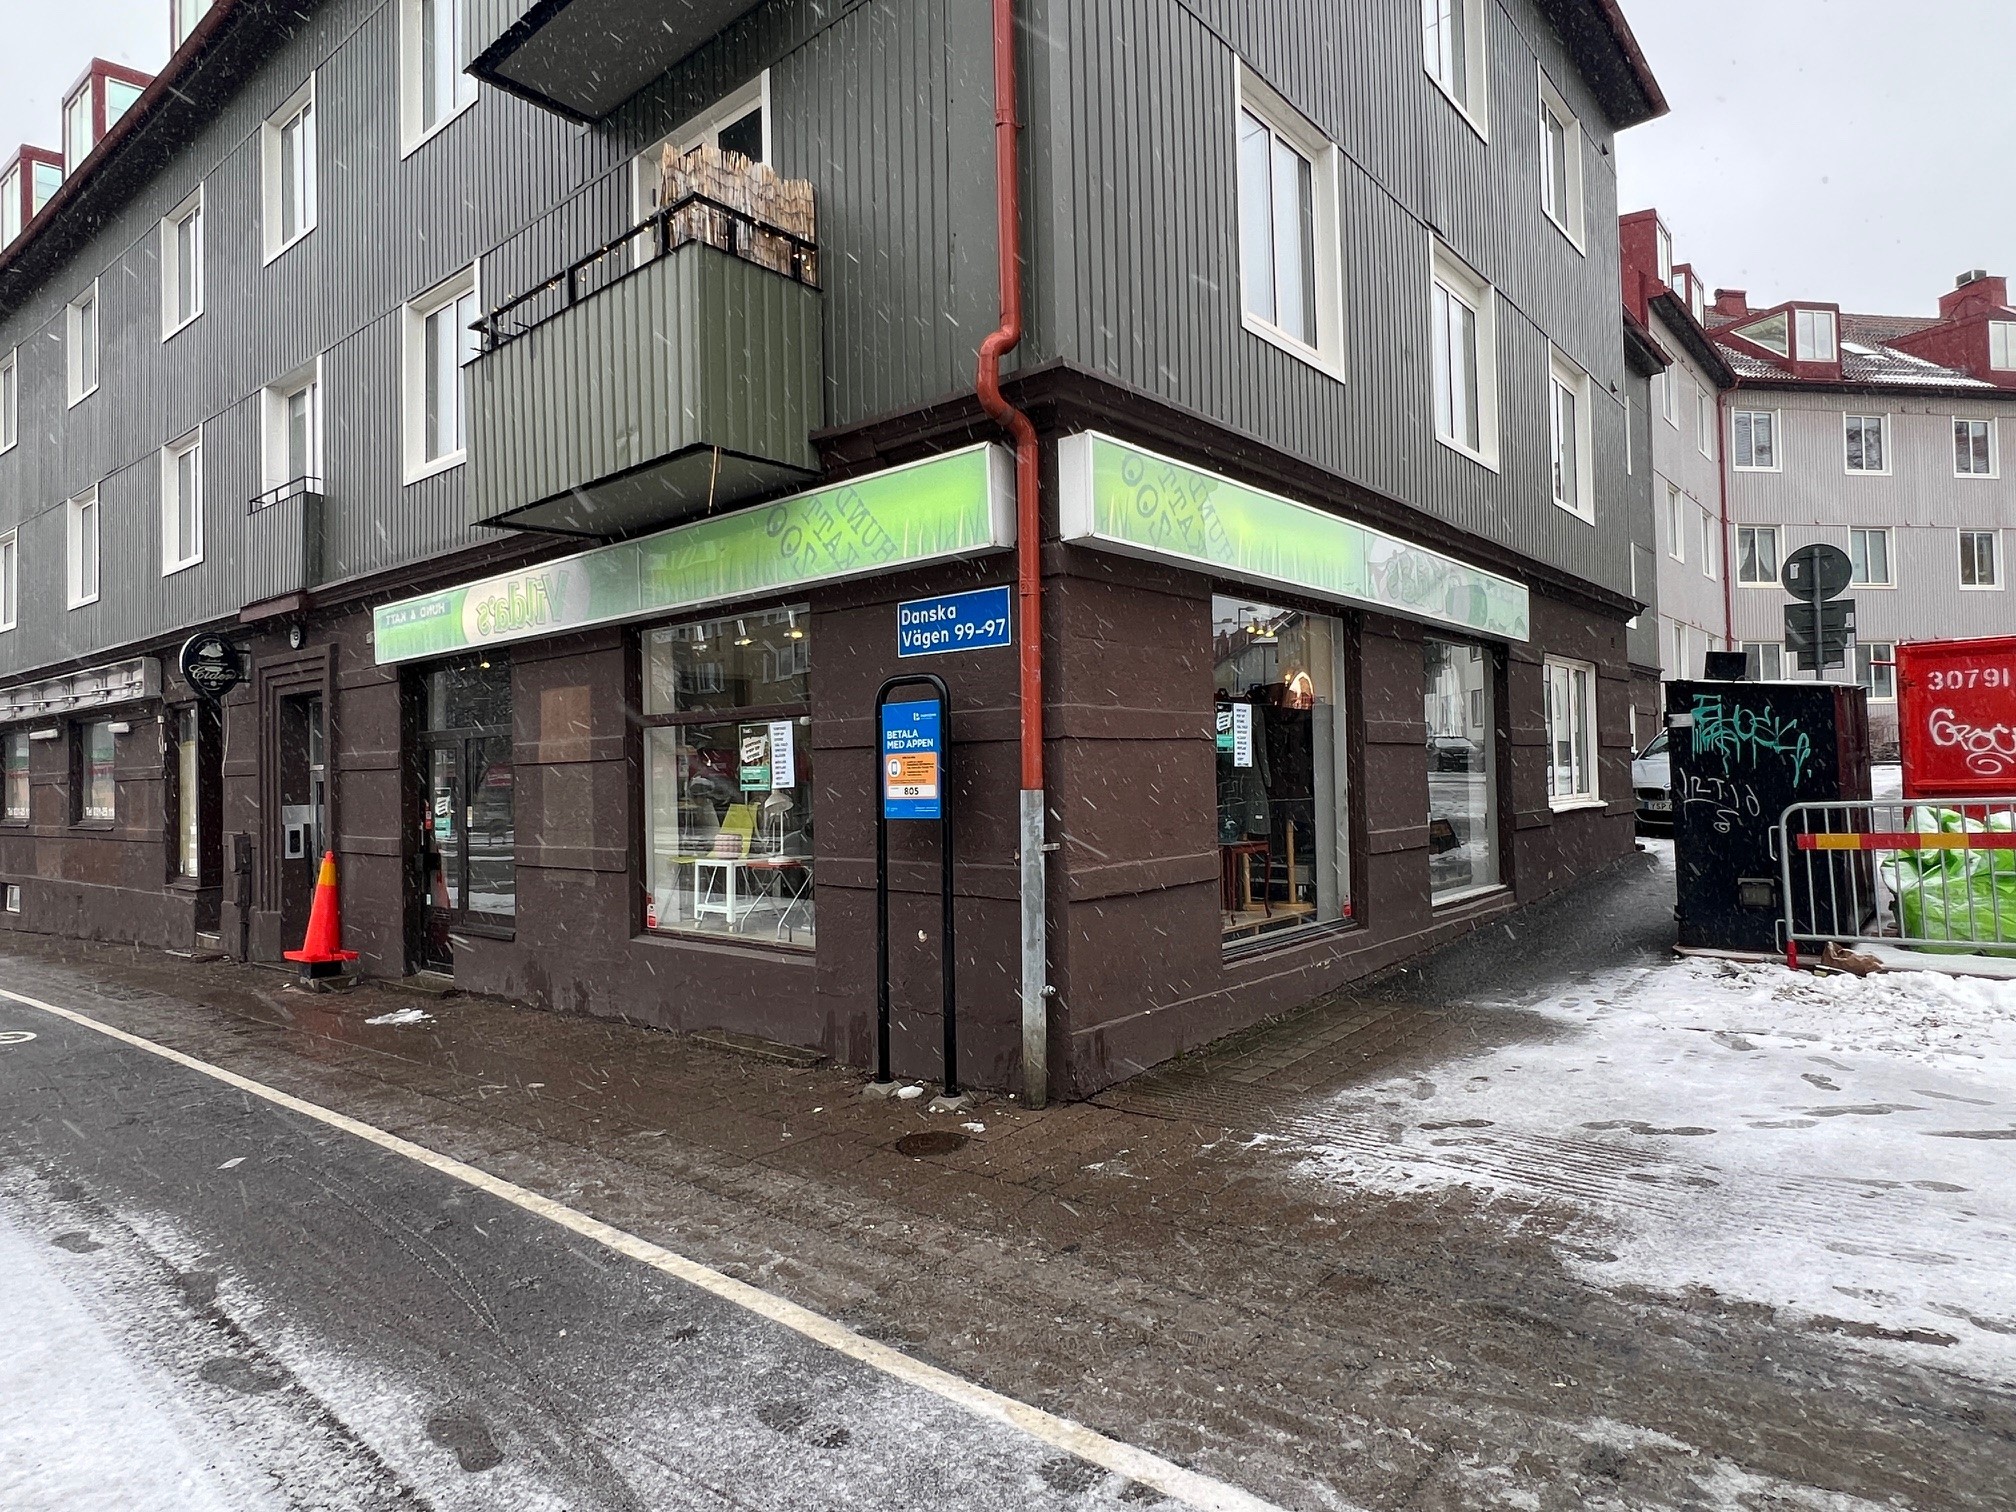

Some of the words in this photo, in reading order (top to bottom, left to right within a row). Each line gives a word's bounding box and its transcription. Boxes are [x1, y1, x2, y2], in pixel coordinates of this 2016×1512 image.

[901, 604, 957, 626] Danska
[902, 629, 950, 649] Vägen
[1927, 668, 2010, 690] 30791
[886, 728, 919, 740] BETALA
[886, 740, 905, 750] MED
[906, 738, 934, 749] APPEN
[903, 786, 920, 796] 805
